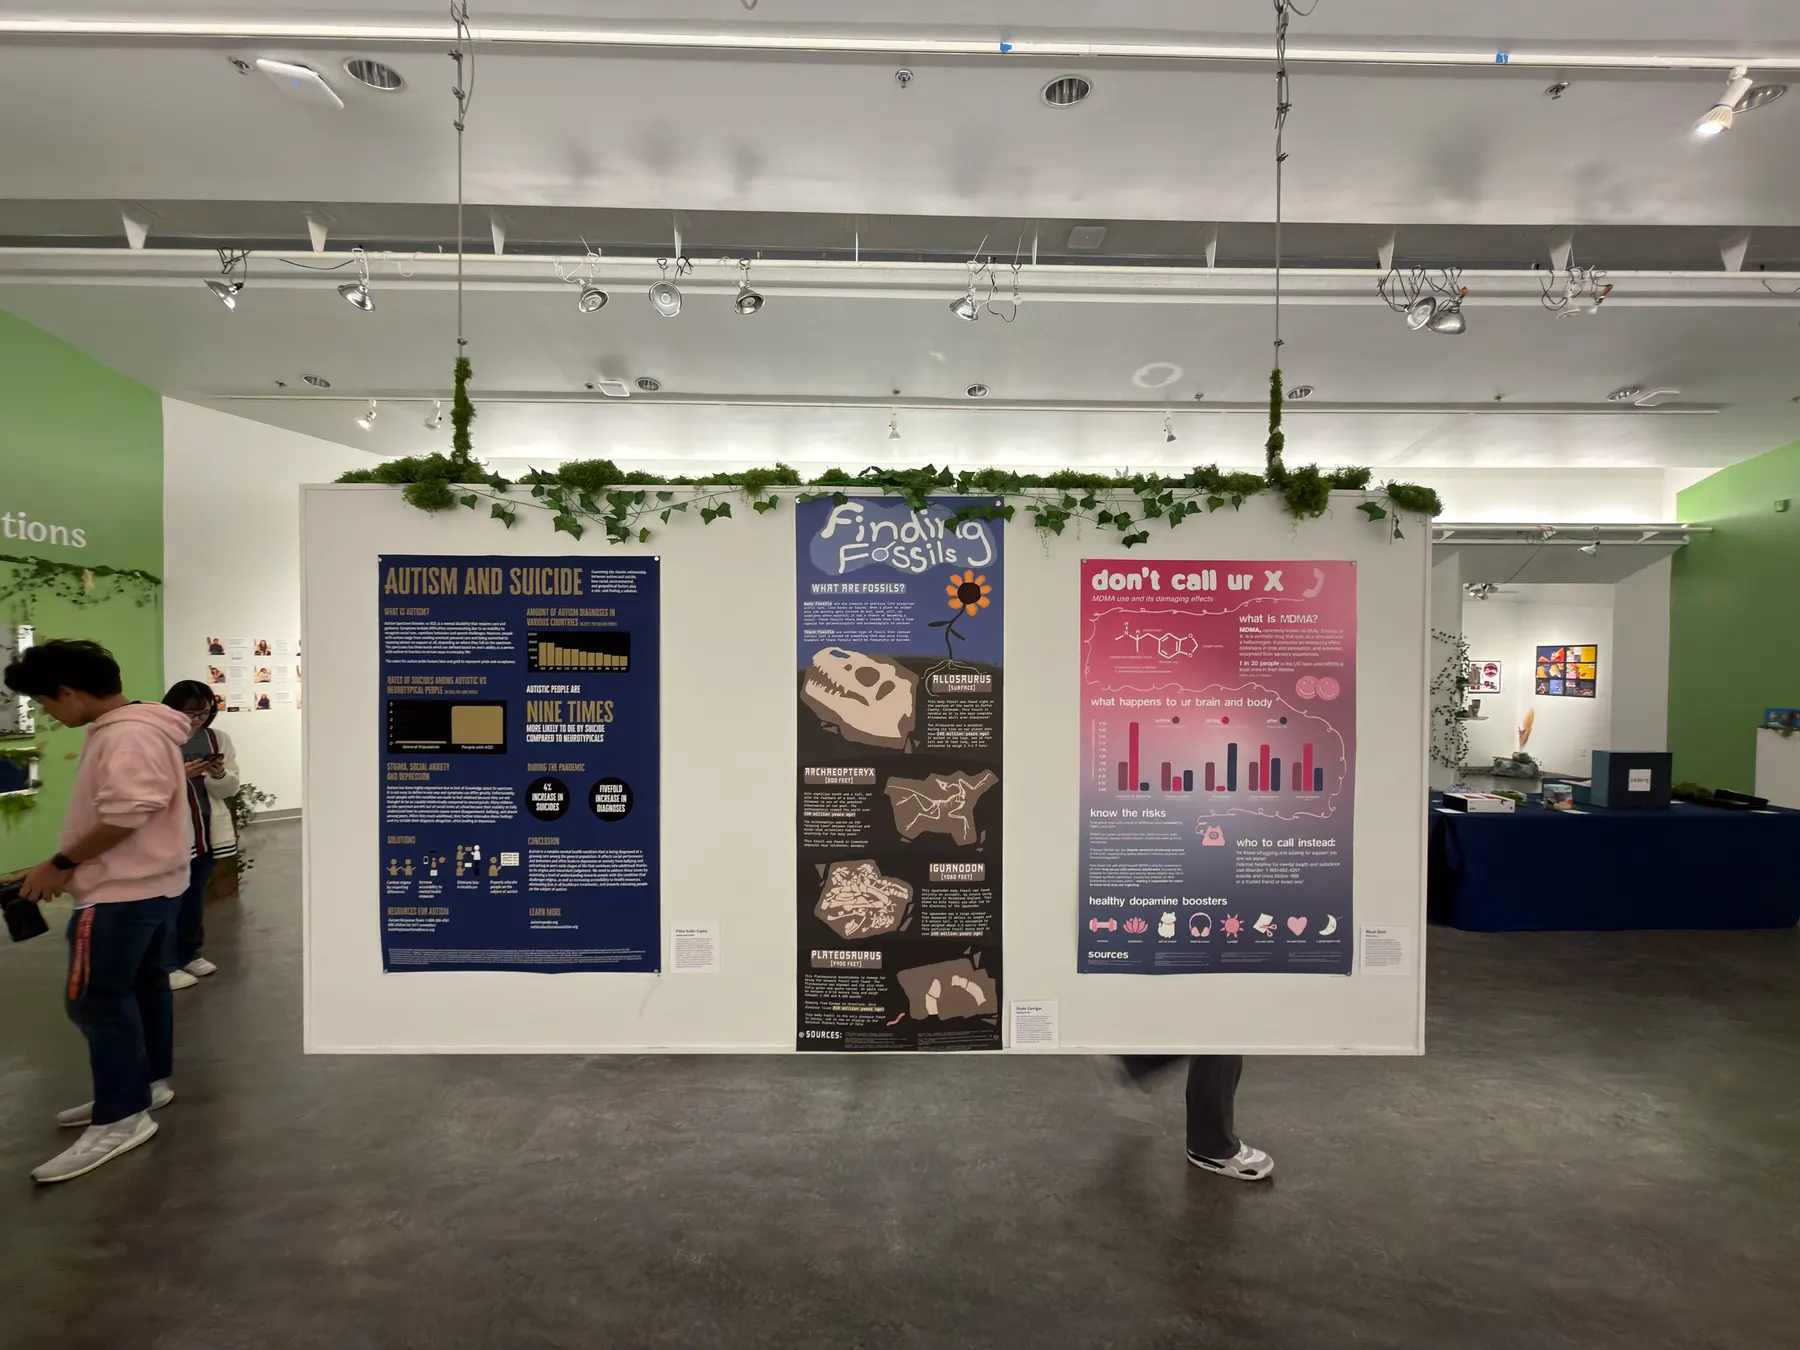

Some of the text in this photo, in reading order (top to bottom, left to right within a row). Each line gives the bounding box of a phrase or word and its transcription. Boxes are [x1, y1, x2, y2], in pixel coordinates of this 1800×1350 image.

[1, 511, 87, 548] tions
[385, 567, 583, 595] AUTISM AND SUICIDE
[1091, 566, 1284, 591] don't call ur X
[812, 584, 905, 593] WHAT ARE FOSSILS?
[1156, 595, 1189, 603] damaging
[526, 608, 615, 616] AMOUNT OF AUTISM DIAGNOSES IN
[526, 618, 579, 626] VARIOUS COUNTRIES
[1239, 614, 1318, 624] what is MDMA?
[404, 676, 410, 685] OF
[455, 676, 477, 685] AUTISTIC
[479, 676, 487, 685] VS
[933, 675, 991, 683] ALLOSAURUS
[425, 686, 443, 695] PEOPLE
[526, 685, 580, 693] AUTISTIC PEOPLE ARE
[1091, 697, 1115, 706] what
[1120, 697, 1161, 708] happens
[1166, 697, 1176, 706] to
[1195, 697, 1220, 706] brain
[1224, 698, 1243, 707] and
[1247, 698, 1272, 709] body
[527, 700, 614, 723] NINE TIMES
[526, 724, 605, 733] MORE LIKELY TO DIE BY SUICIDE
[526, 734, 604, 743] COMPARED TO NEUROTYPICALS
[804, 768, 875, 776] ARCHAEOPTERYX
[599, 784, 623, 793] FIVEFOLD
[531, 793, 564, 801] INCREASE IN
[595, 794, 627, 803] INCREASE IN
[536, 802, 560, 811] SUICIDES
[596, 804, 626, 813] DIAGNOSES
[1090, 808, 1166, 818] know the risks
[1236, 838, 1336, 847] who to call instead:
[929, 863, 984, 873] IGUANODON
[1089, 896, 1228, 907] healthy dopamine boosters
[529, 907, 562, 916] LEARN MORE
[811, 950, 882, 960] PLATEOSAURUS
[1088, 950, 1129, 959] sources
[806, 1030, 842, 1039] SOURCES:
